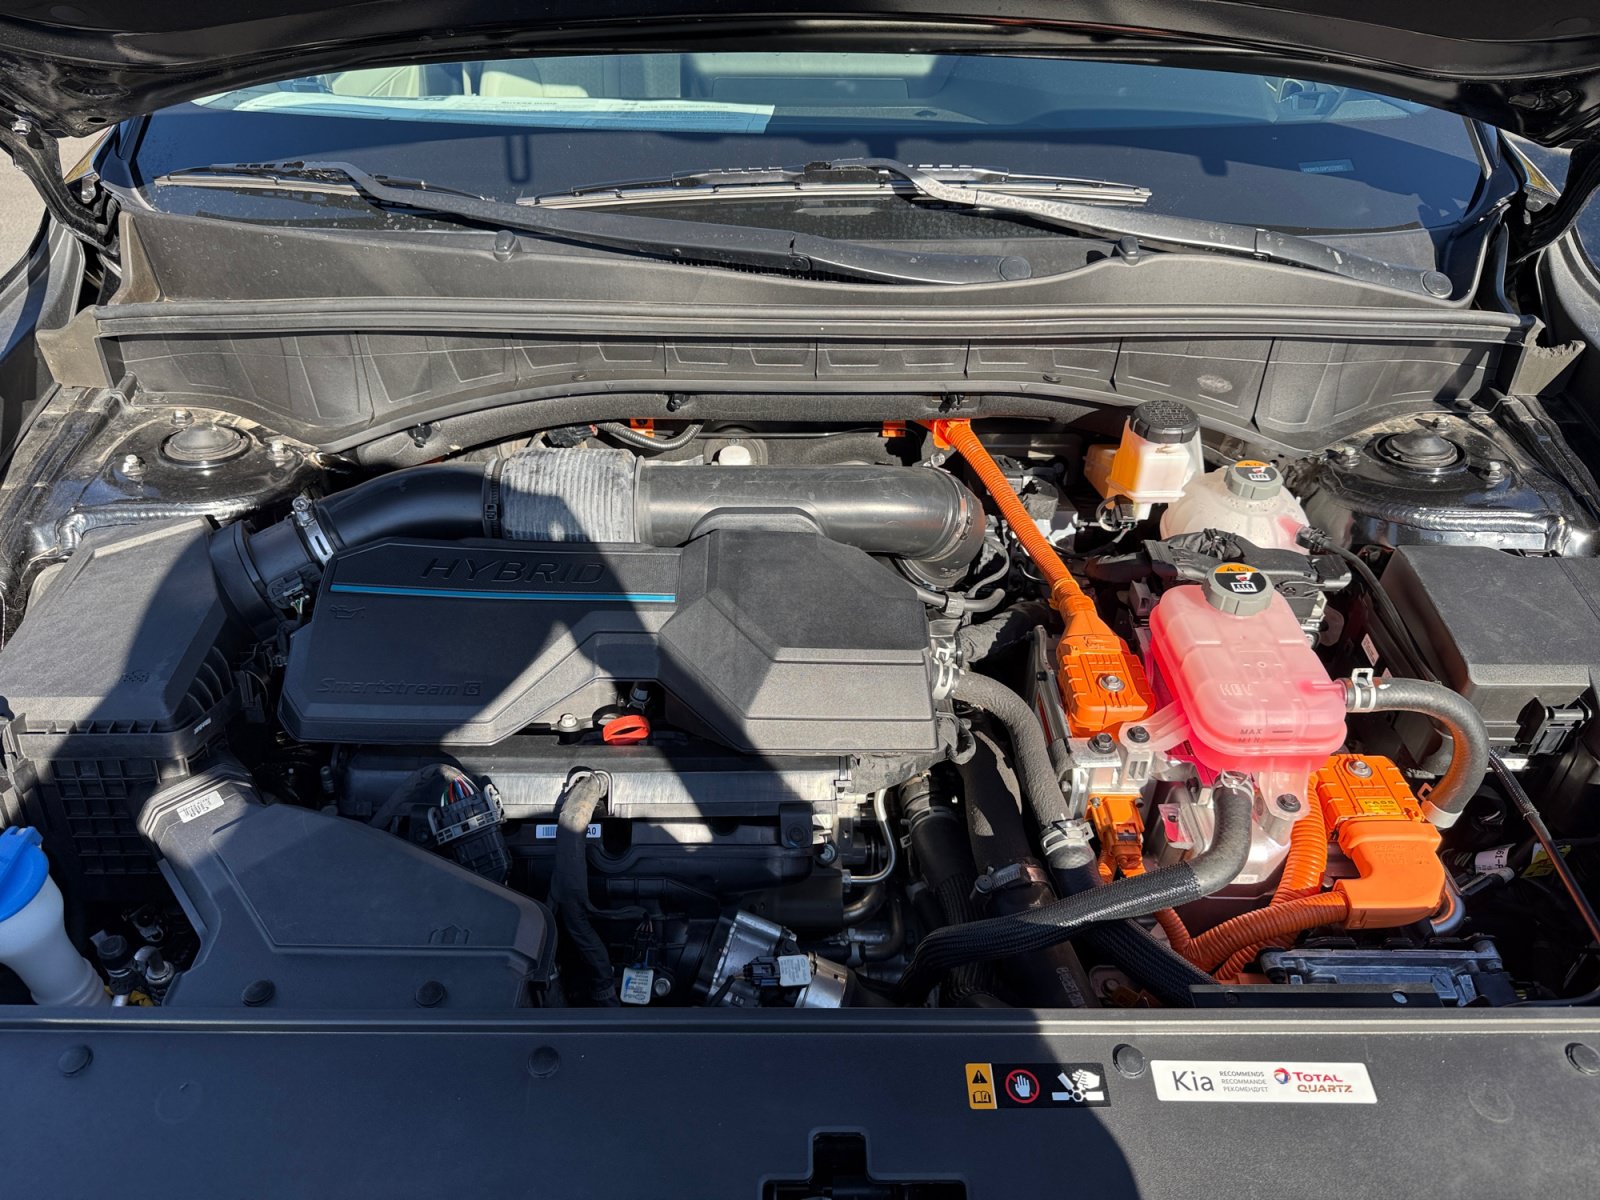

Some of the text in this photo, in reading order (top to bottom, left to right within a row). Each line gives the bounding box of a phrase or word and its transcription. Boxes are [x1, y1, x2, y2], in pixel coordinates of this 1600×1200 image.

[420, 558, 606, 584] HYBRID
[316, 677, 482, 696] Smartstream G
[1172, 1070, 1215, 1092] Kia
[1292, 1071, 1344, 1082] TOTAL
[1297, 1084, 1353, 1093] QUARTZ
